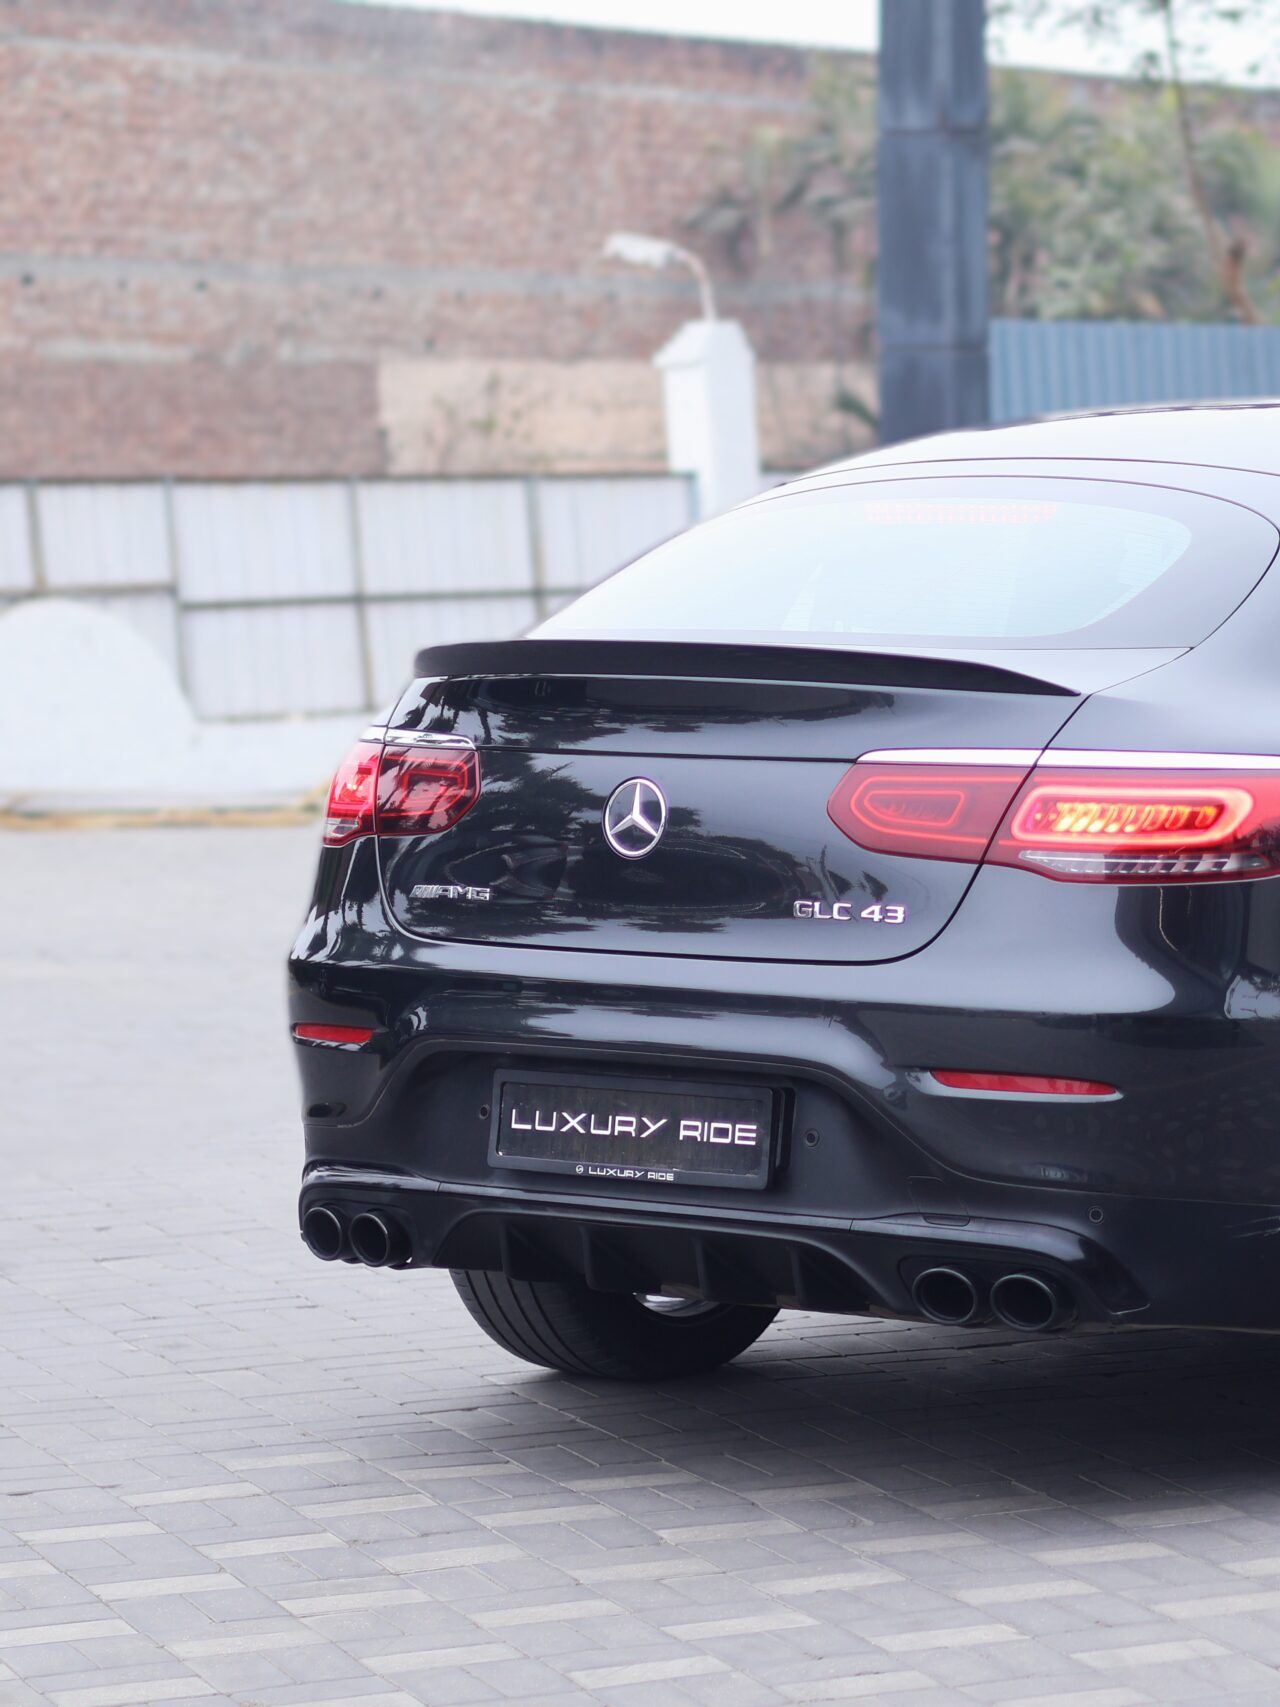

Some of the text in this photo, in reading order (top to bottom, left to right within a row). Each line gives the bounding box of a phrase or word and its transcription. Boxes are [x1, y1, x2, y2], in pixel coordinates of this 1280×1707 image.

[793, 900, 905, 923] GLC 43
[511, 1108, 757, 1145] LUXURY RIDE
[588, 1166, 674, 1181] LUXURY RIDE
